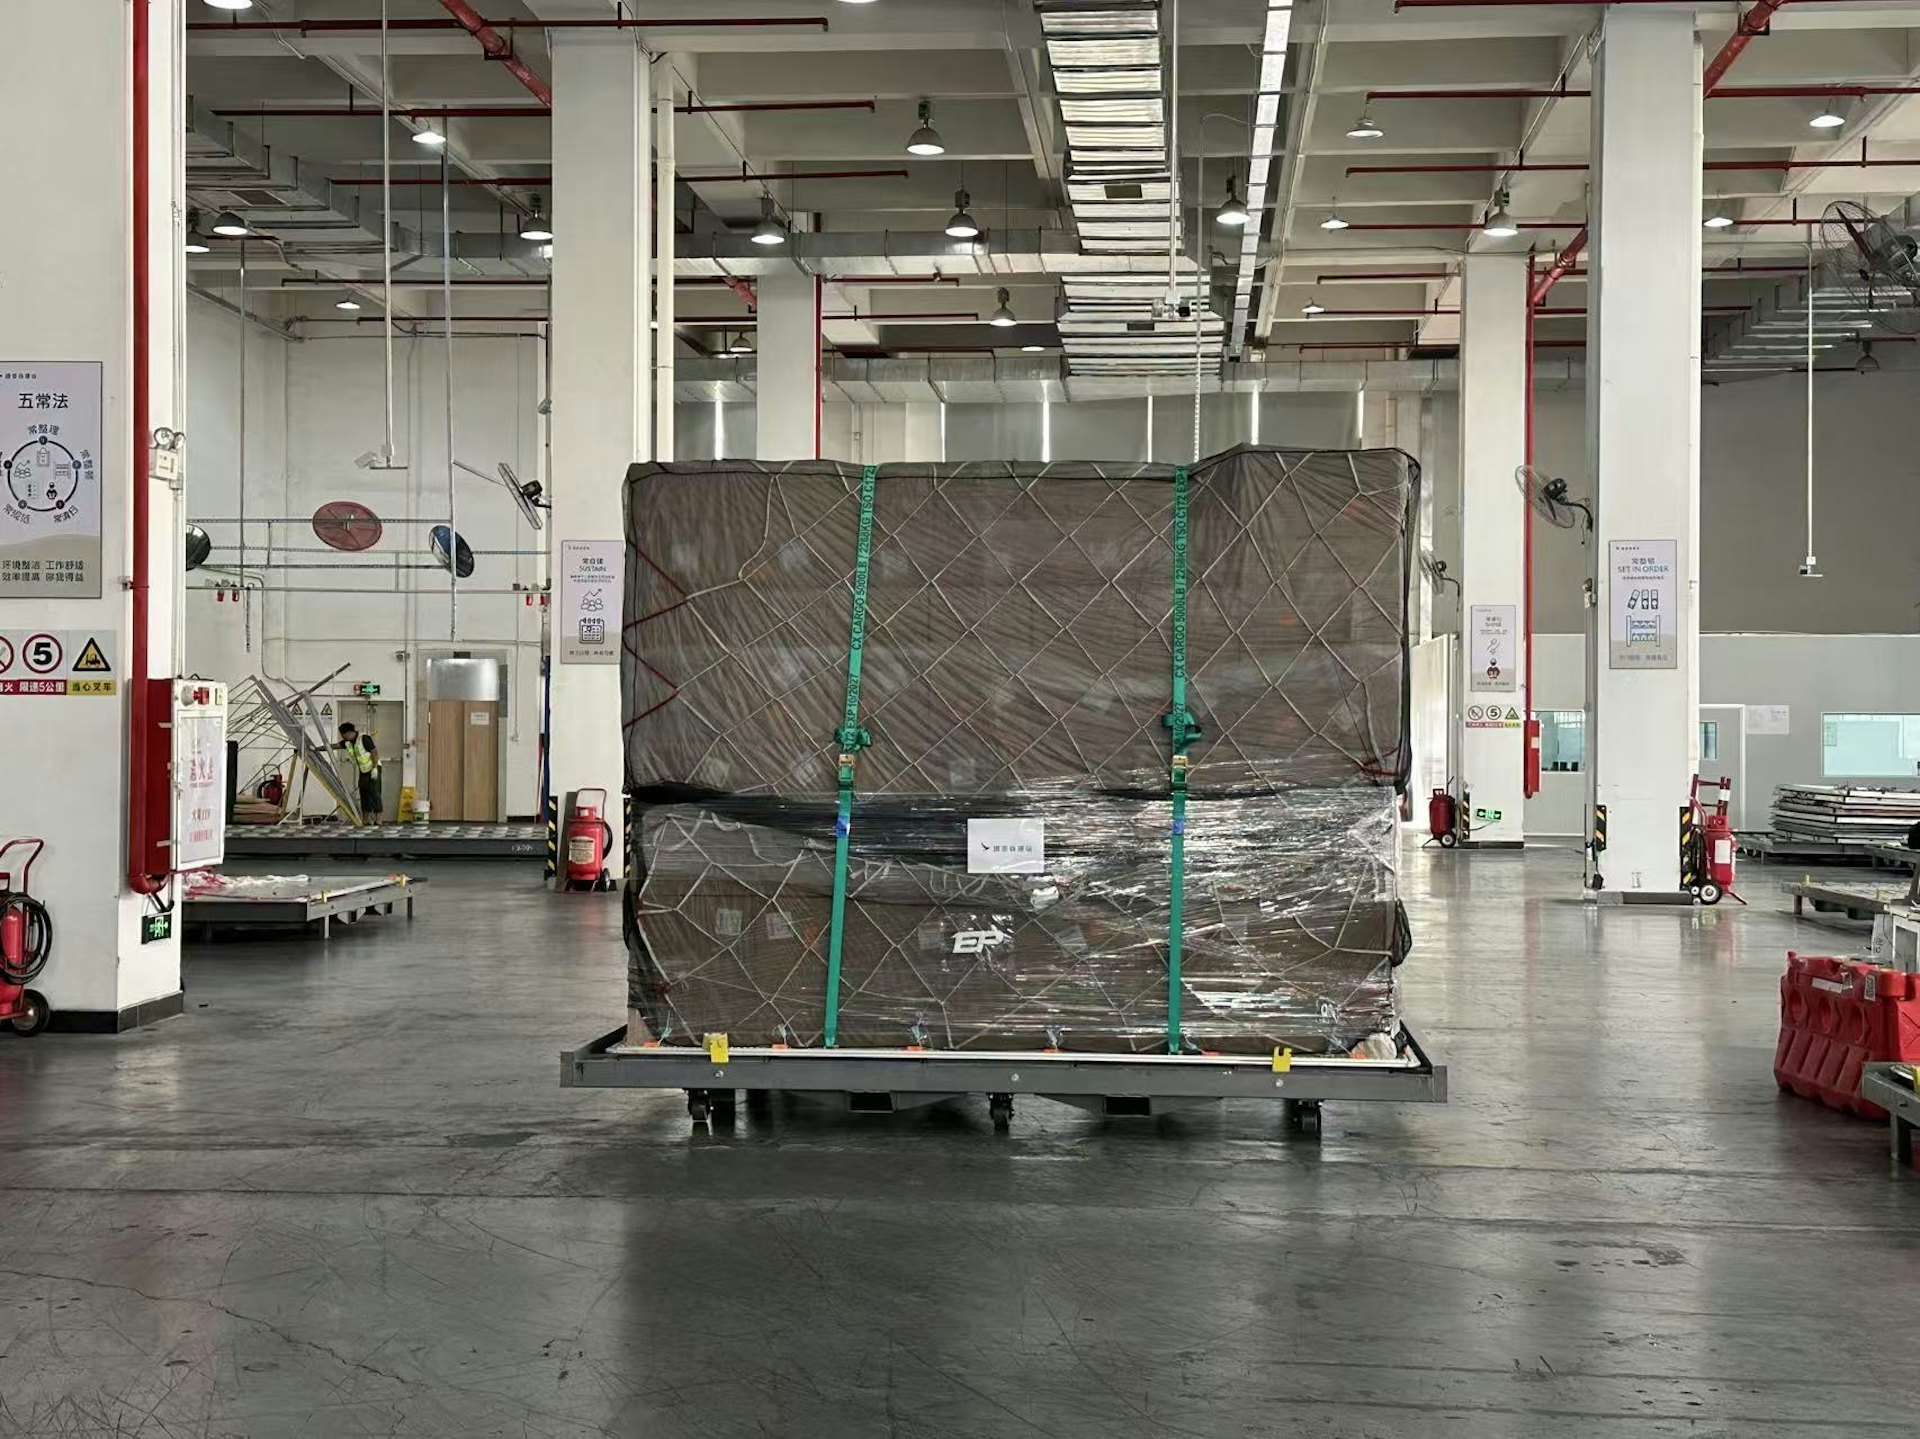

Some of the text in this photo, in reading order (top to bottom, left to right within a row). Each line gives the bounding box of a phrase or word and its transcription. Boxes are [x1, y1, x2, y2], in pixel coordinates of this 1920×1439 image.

[18, 392, 69, 409] 五常法
[864, 468, 875, 493] C172
[1177, 473, 1186, 493] EXP
[862, 495, 873, 514] TSO
[1177, 496, 1187, 519] C172
[1176, 521, 1186, 541] TSO
[856, 561, 867, 596] 5000LB
[1617, 565, 1669, 573] SET IN ORDER
[1175, 588, 1186, 623] 5000LB
[854, 598, 865, 634] CARGO
[851, 637, 863, 651] CX
[1175, 625, 1185, 661] CARGO
[32, 642, 52, 666] 5
[1175, 664, 1185, 679] CX
[0, 682, 14, 693] 火
[20, 682, 65, 693] 限速5公里
[72, 682, 112, 692] 当心叉车
[848, 673, 859, 708] 10/2027
[846, 710, 856, 729] EXP
[1490, 708, 1498, 717] 5
